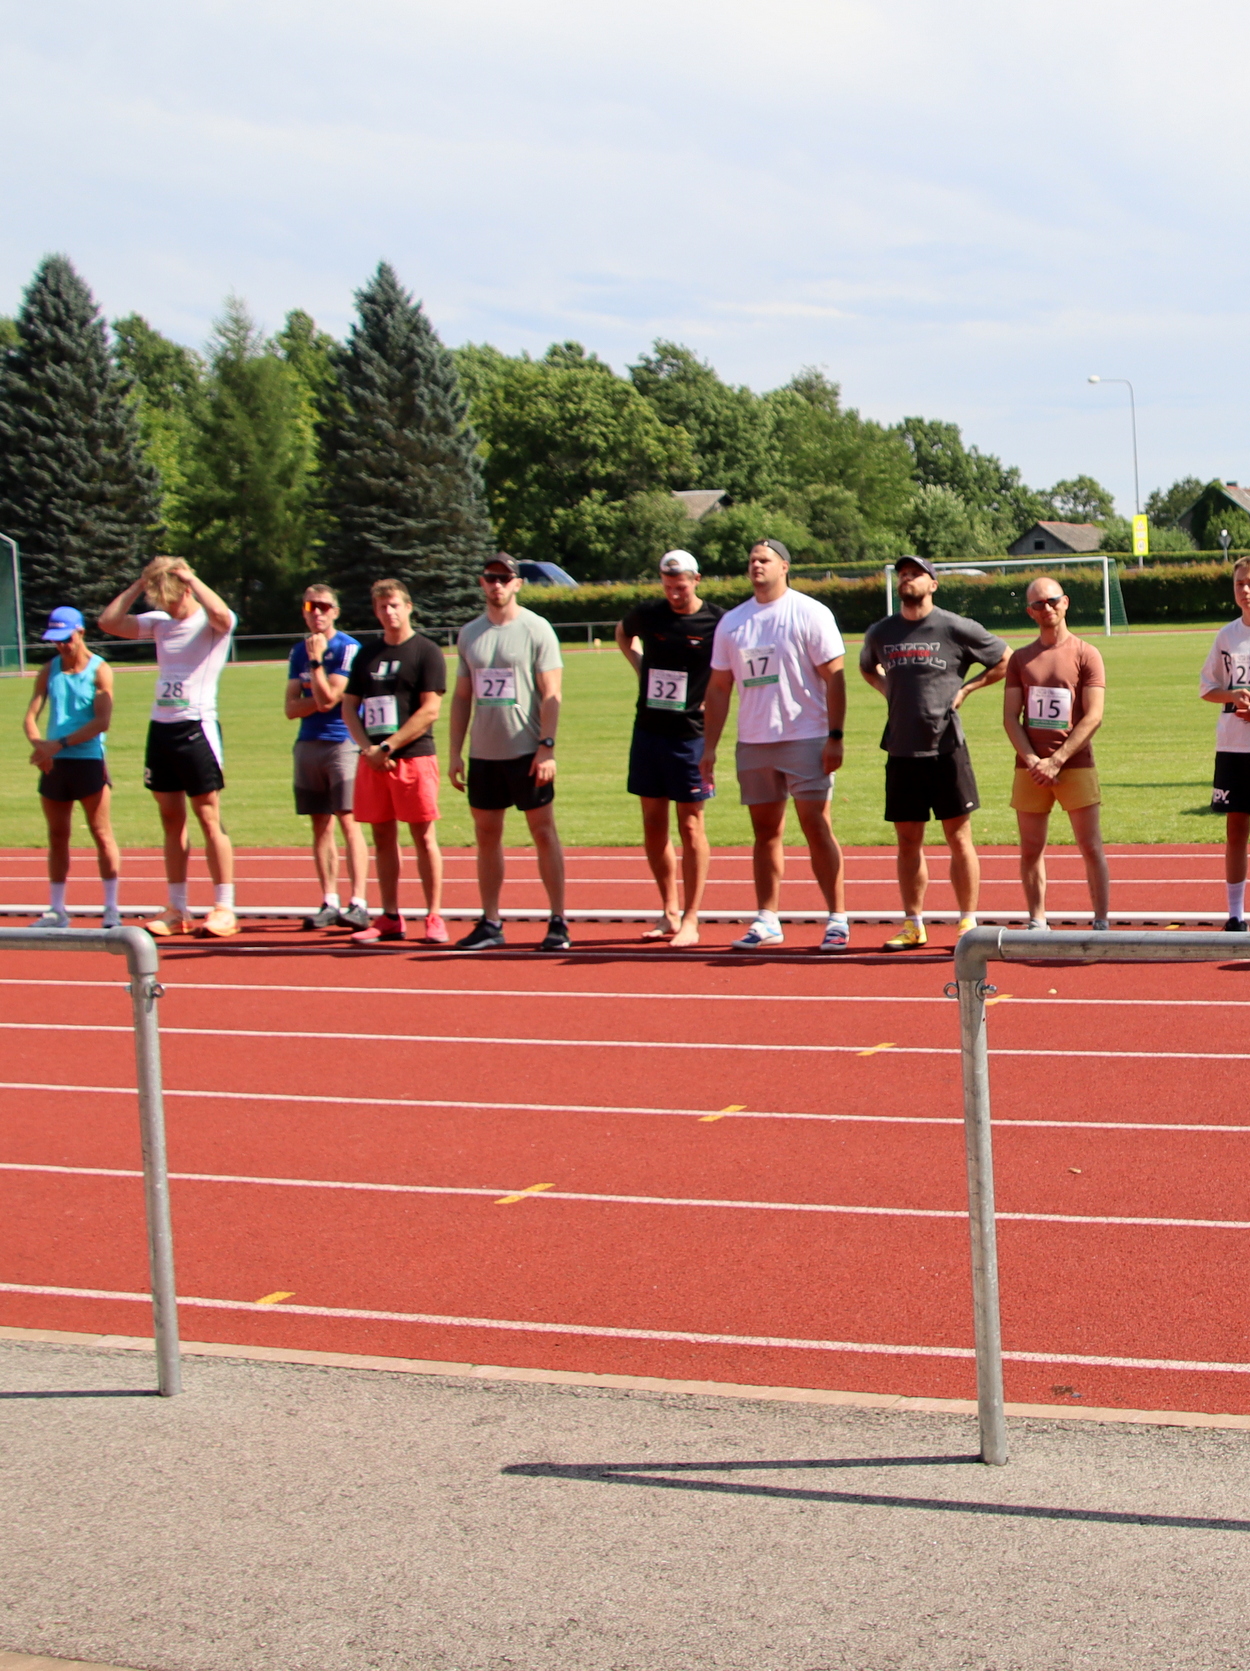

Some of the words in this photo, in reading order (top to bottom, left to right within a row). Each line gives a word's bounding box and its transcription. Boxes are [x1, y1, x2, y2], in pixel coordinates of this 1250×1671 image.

[747, 656, 769, 677] 17
[161, 681, 183, 698] 28
[483, 679, 506, 697] 27
[653, 680, 677, 699] 32
[367, 707, 386, 726] 31
[1036, 699, 1061, 718] 15
